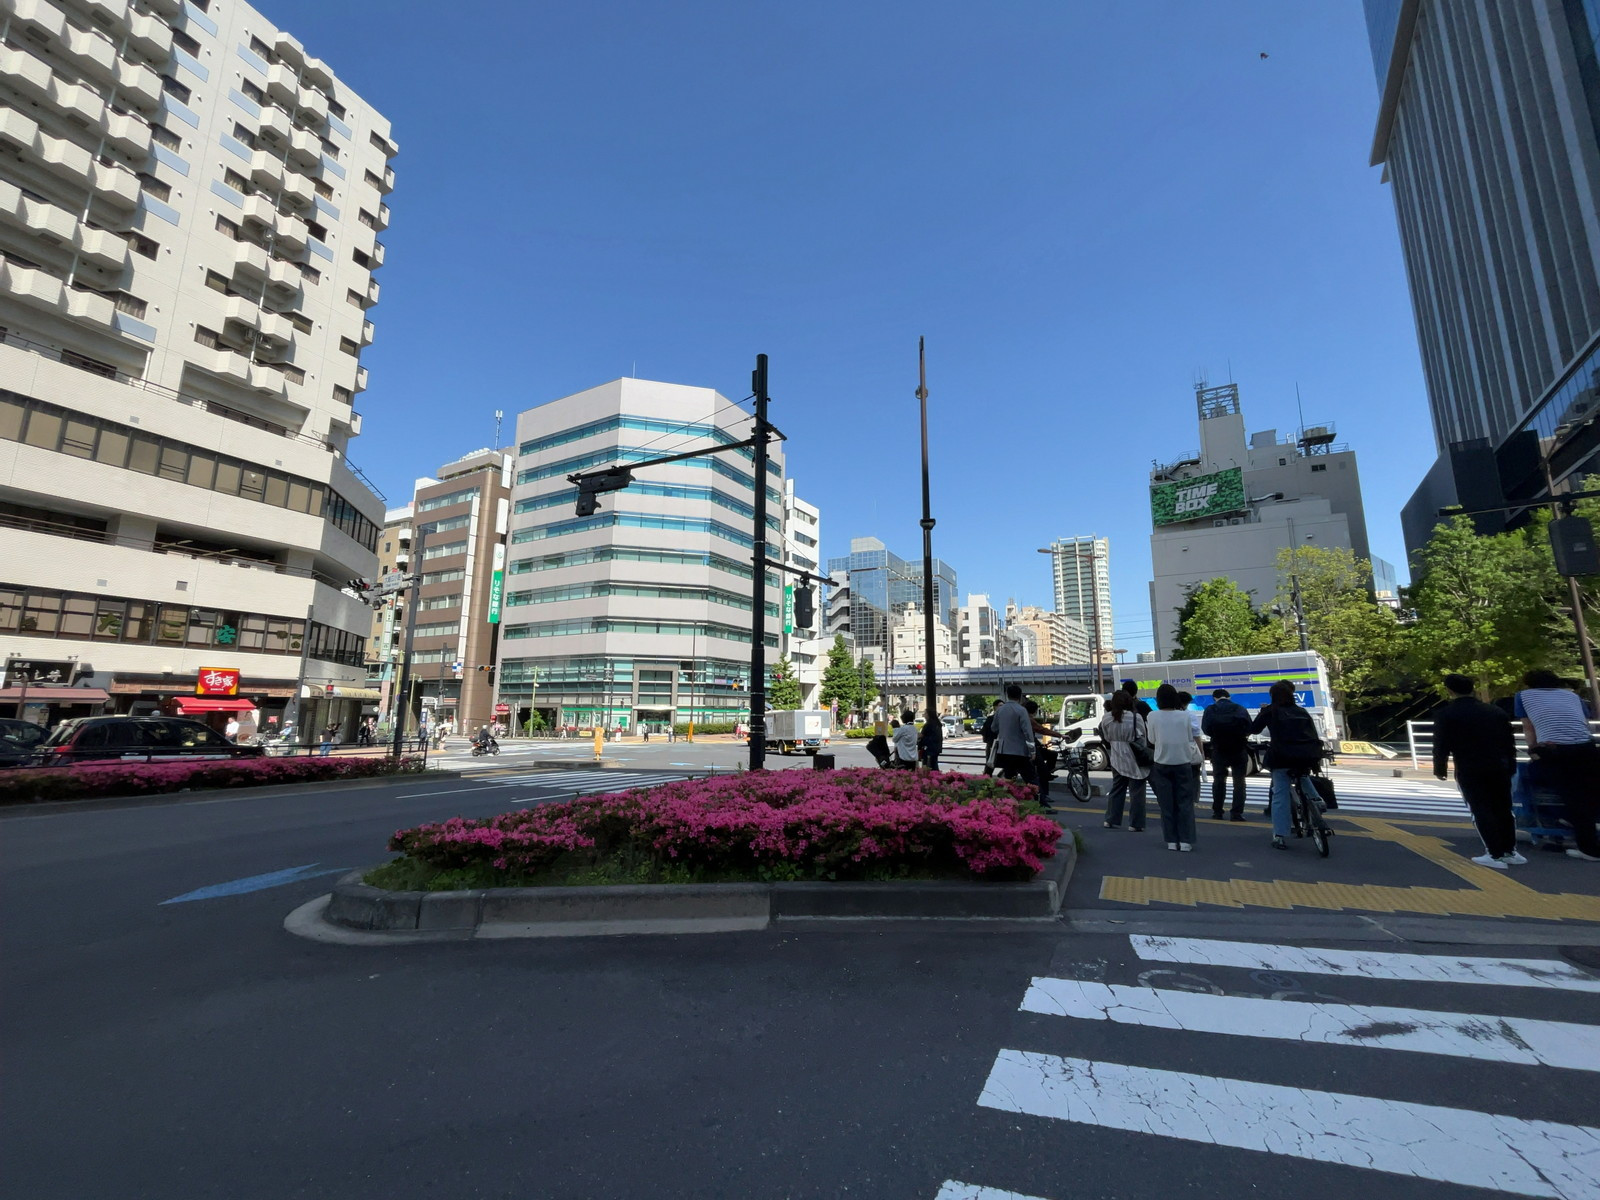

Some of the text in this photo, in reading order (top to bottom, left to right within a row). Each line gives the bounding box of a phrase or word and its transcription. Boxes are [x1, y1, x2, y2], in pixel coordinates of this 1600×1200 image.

[1175, 482, 1218, 502] TIME
[1174, 496, 1210, 514] BOX
[491, 580, 500, 615] りそな銀行
[203, 670, 235, 688] すき家
